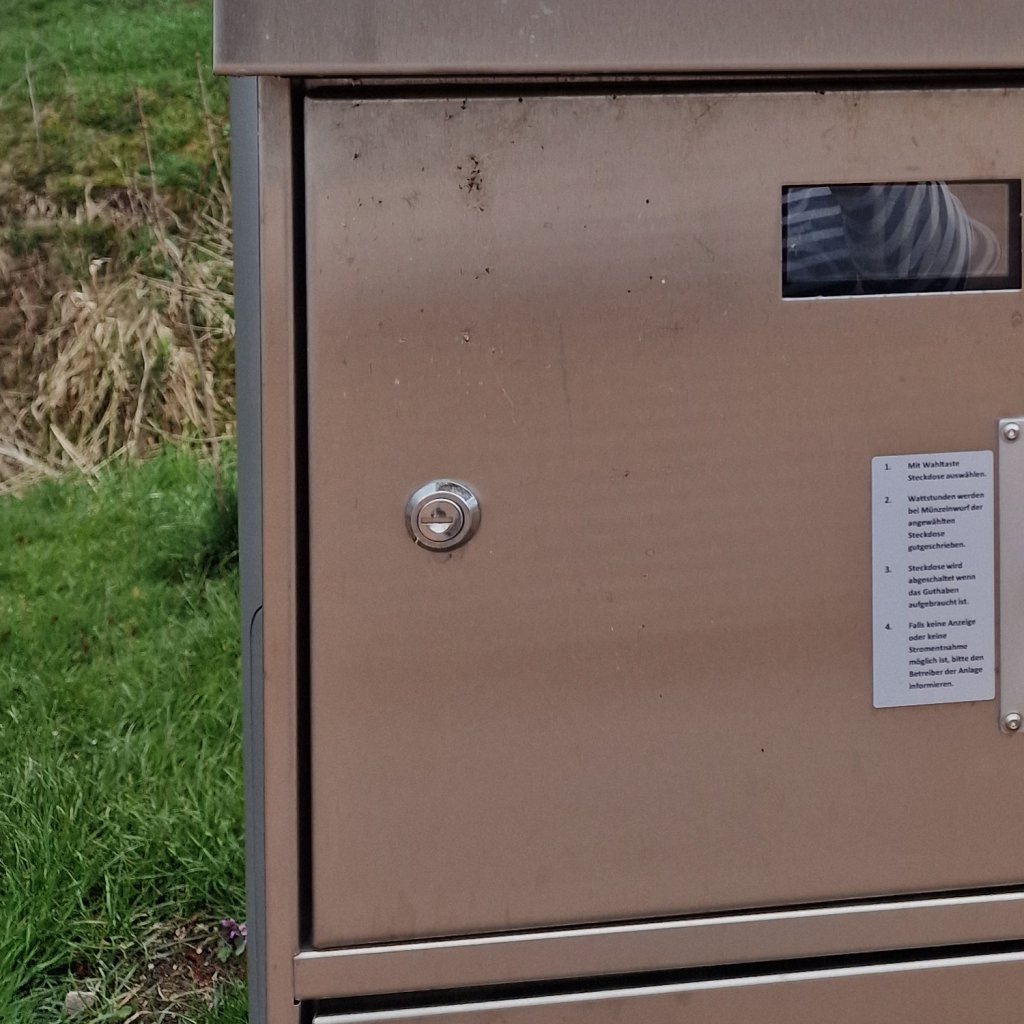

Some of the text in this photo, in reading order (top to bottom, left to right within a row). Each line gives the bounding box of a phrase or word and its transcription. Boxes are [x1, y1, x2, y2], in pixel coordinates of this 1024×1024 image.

[884, 460, 960, 471] 1. Mit Wahltaste
[907, 471, 987, 481] Steckdose auswählen.
[884, 496, 892, 504] 2.
[907, 494, 956, 502] Wattstunden
[907, 503, 983, 515] bei Münzeinwurf der
[907, 517, 956, 527] angewählten
[907, 530, 945, 539] Steckdose
[907, 541, 966, 552] gutgeschrieben.
[884, 565, 892, 574] 3.
[908, 564, 945, 572] Steckdose
[908, 575, 955, 585] abgeschaltet
[908, 587, 960, 596] das Guthaben
[908, 598, 970, 609] aufgebraucht ist.
[908, 621, 925, 630] Falls
[926, 620, 947, 628] keine
[947, 618, 976, 627] Anzeige
[908, 632, 948, 642] oder keine
[908, 643, 968, 654] Stromentnahme
[908, 656, 938, 667] möglich
[951, 655, 969, 663] bitte
[970, 654, 985, 662] den
[908, 666, 983, 678] Betreiber der Anlage
[908, 680, 955, 690] informieren.
